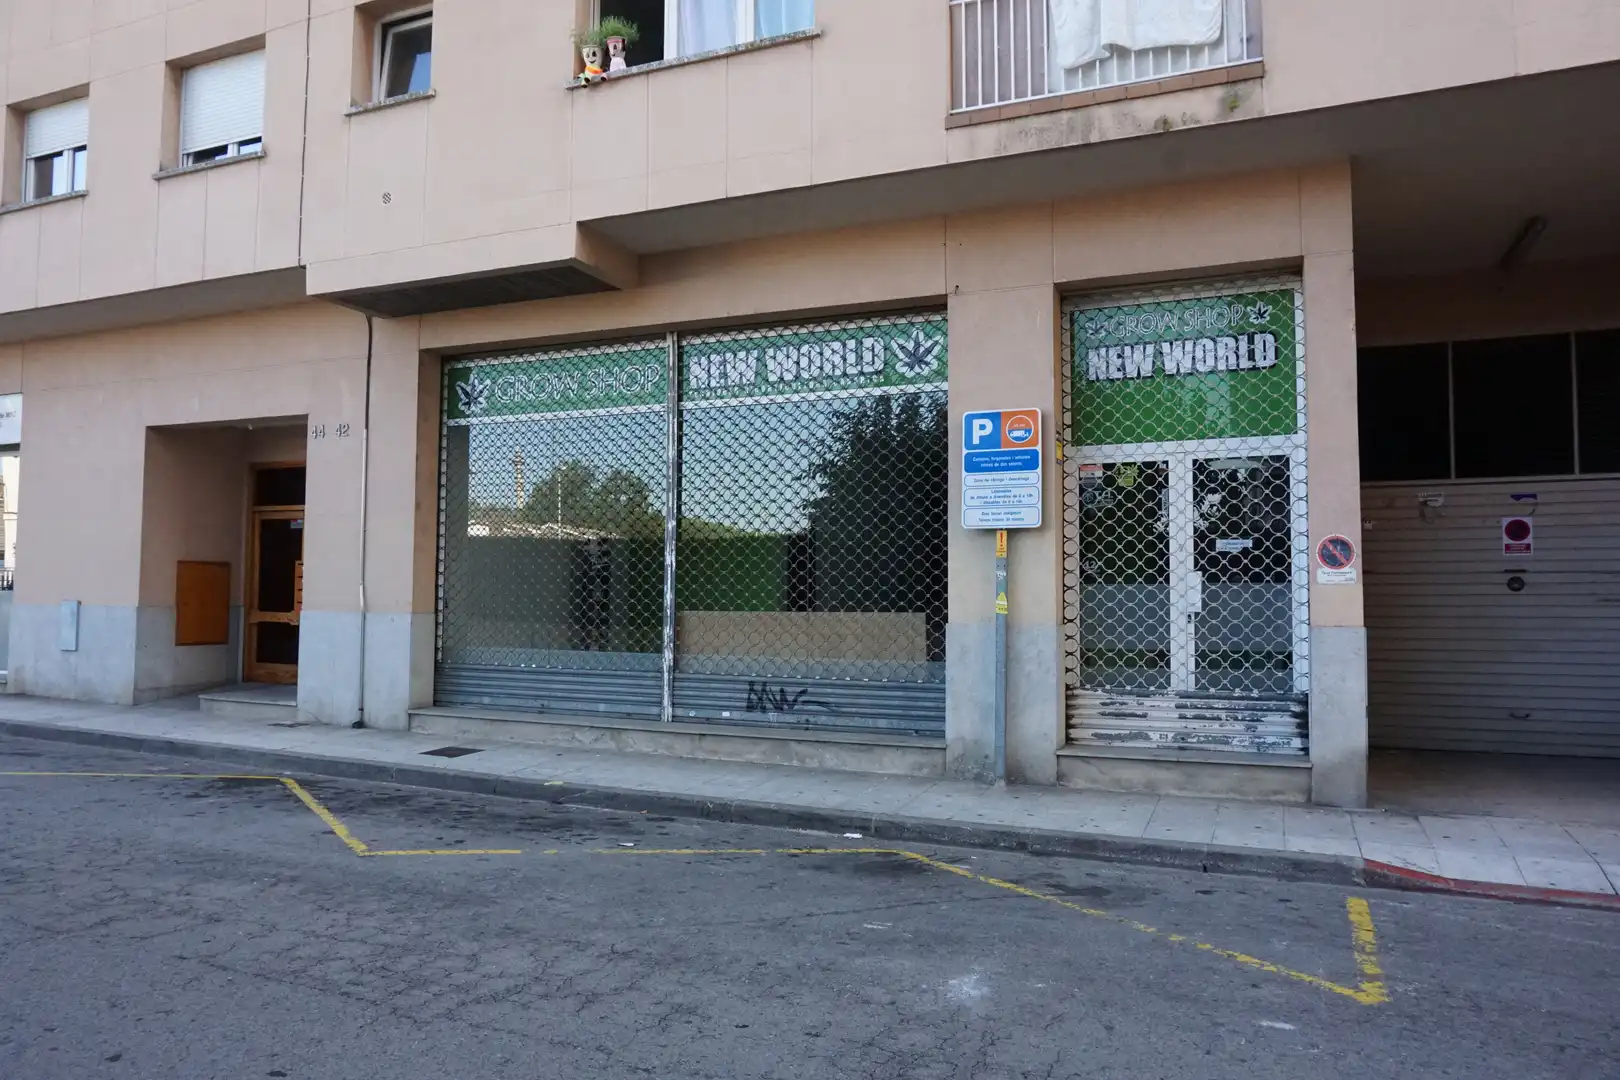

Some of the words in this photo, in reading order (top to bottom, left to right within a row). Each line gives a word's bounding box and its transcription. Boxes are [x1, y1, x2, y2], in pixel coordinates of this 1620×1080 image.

[1109, 311, 1178, 338] GROW
[1184, 304, 1244, 332] SHOP
[688, 349, 759, 389] NEW
[764, 336, 885, 382] WORLD
[1087, 343, 1155, 381] NEW
[1160, 332, 1277, 376] WORLD
[495, 370, 580, 403] GROW
[585, 364, 661, 398] SHOP
[311, 424, 326, 440] 44
[335, 423, 350, 438] 42
[972, 418, 994, 445] P
